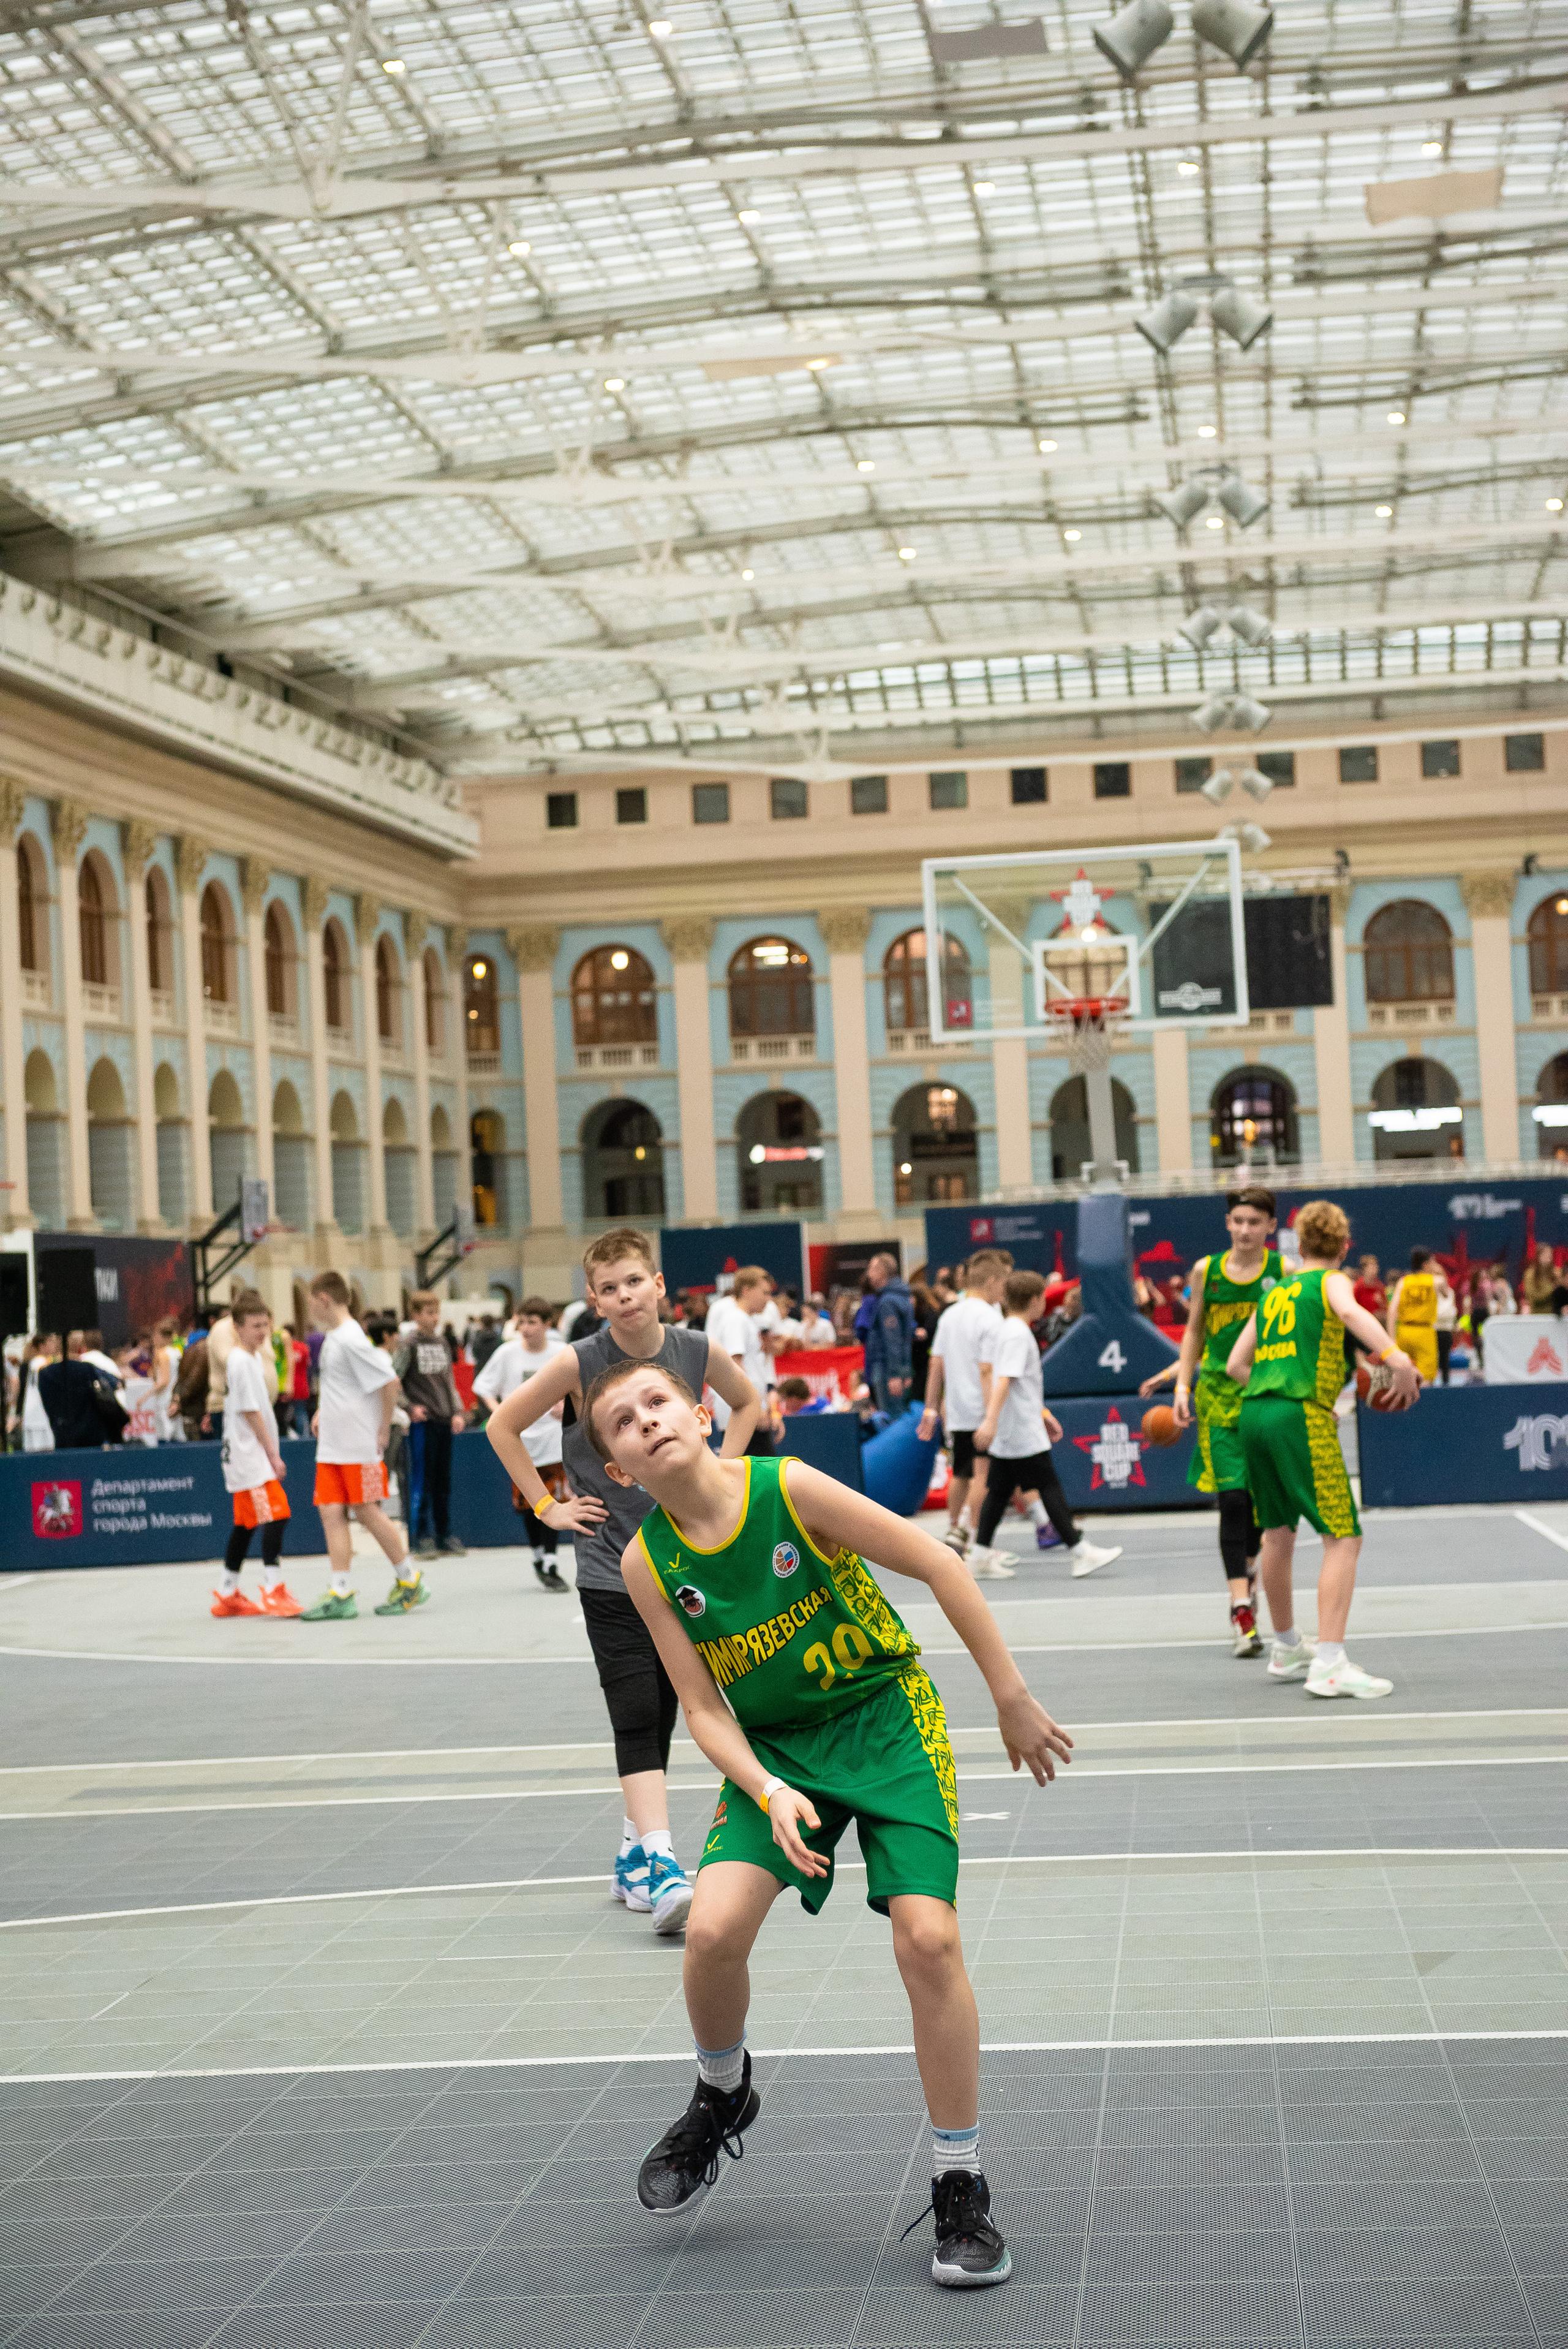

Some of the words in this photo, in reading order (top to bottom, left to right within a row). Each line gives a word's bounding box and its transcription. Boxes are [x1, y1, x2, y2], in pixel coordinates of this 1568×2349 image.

[1262, 1281, 1302, 1339] 96
[1098, 1340, 1128, 1373] 4
[91, 1477, 194, 1497] Департамент
[92, 1497, 146, 1515] спорта
[93, 1516, 148, 1534] города
[150, 1512, 213, 1529] Москвы
[695, 1586, 834, 1689] ИМИРЯЗЕВСКАЯ
